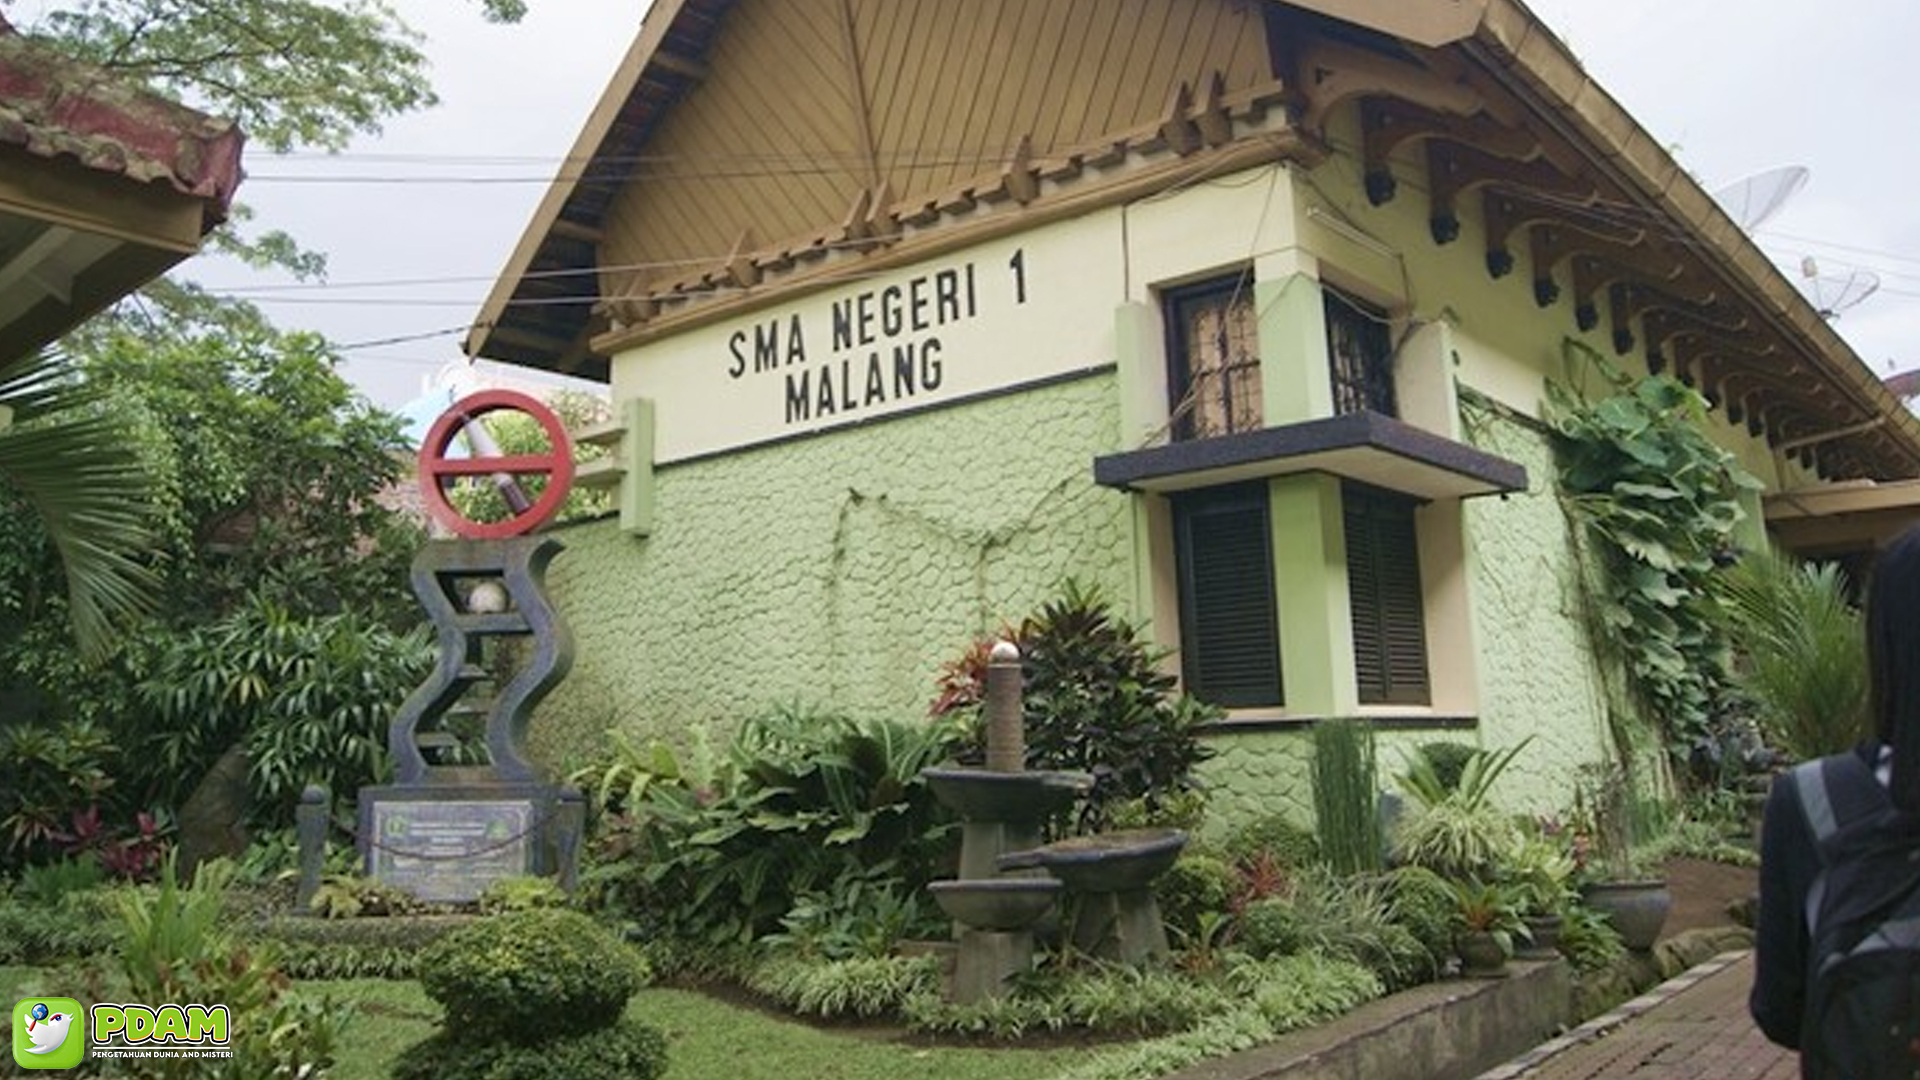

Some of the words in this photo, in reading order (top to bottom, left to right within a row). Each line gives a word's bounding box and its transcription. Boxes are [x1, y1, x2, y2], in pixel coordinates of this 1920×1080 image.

[729, 313, 805, 378] SMA
[832, 263, 976, 352] NEGERI
[1009, 248, 1027, 303] 1
[785, 337, 942, 424] MALANG
